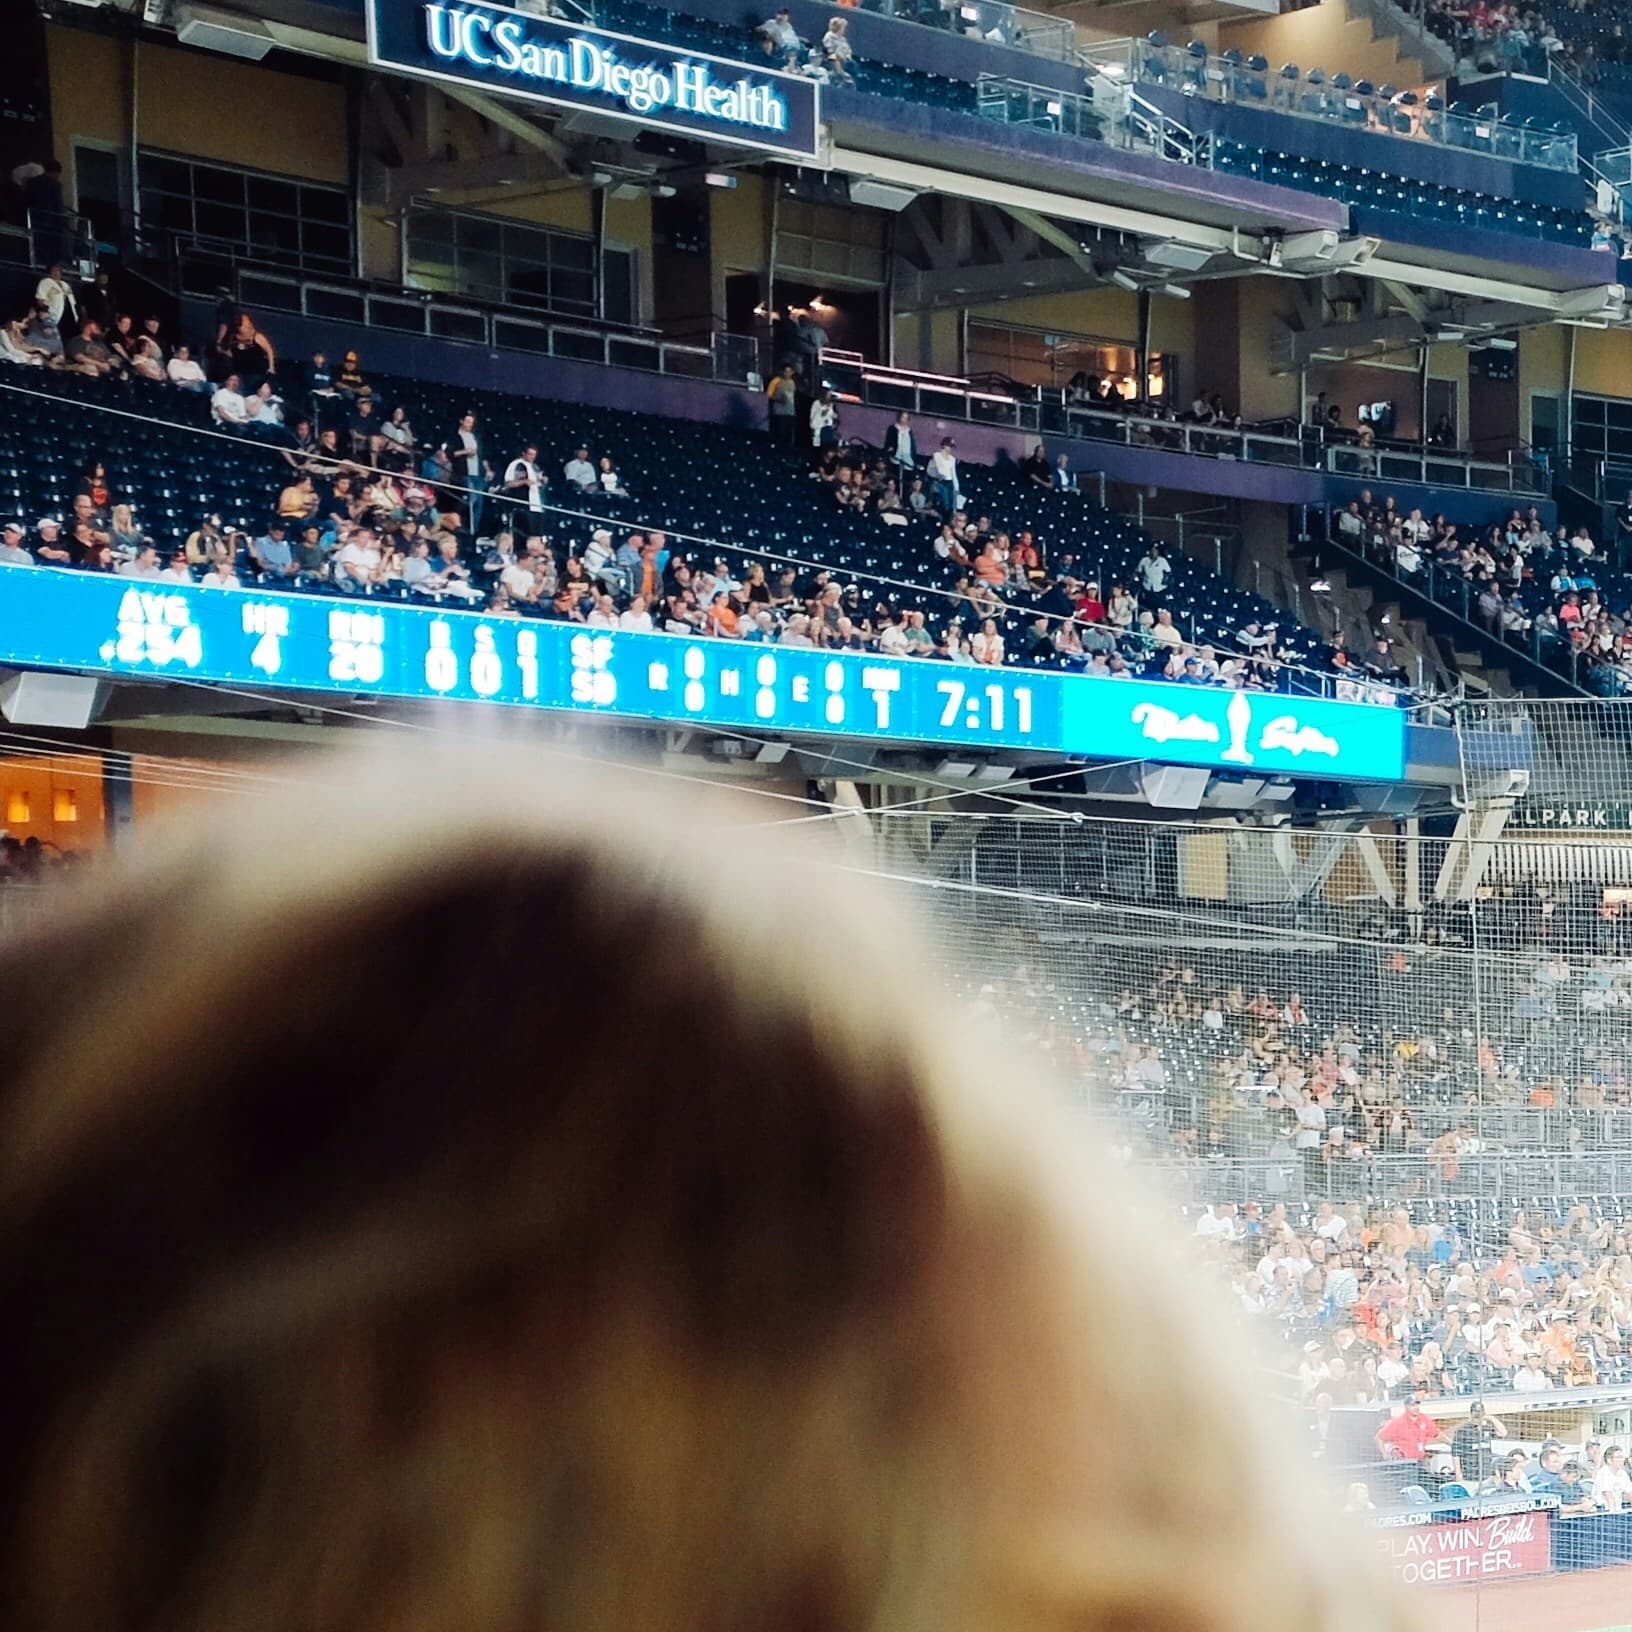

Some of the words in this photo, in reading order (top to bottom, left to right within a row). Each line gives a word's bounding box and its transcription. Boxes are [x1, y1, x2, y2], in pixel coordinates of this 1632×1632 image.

[423, 3, 490, 65] UC
[493, 21, 566, 81] San
[566, 36, 671, 111] Diego
[672, 61, 787, 130] Health
[117, 588, 190, 628] AVG
[242, 602, 290, 636] HR
[251, 631, 282, 675] 4
[474, 624, 496, 652] S
[570, 633, 614, 670] SF
[425, 648, 458, 691] 0
[470, 651, 502, 696] 0
[516, 655, 538, 699] 1
[570, 669, 617, 705] SD
[792, 675, 810, 703] E
[936, 680, 1033, 733] 7:11
[1366, 1512, 1432, 1528] ADRES.COM
[1375, 1533, 1433, 1559] PLAY.
[1437, 1527, 1484, 1552] WIN.
[1485, 1516, 1535, 1551] Build.
